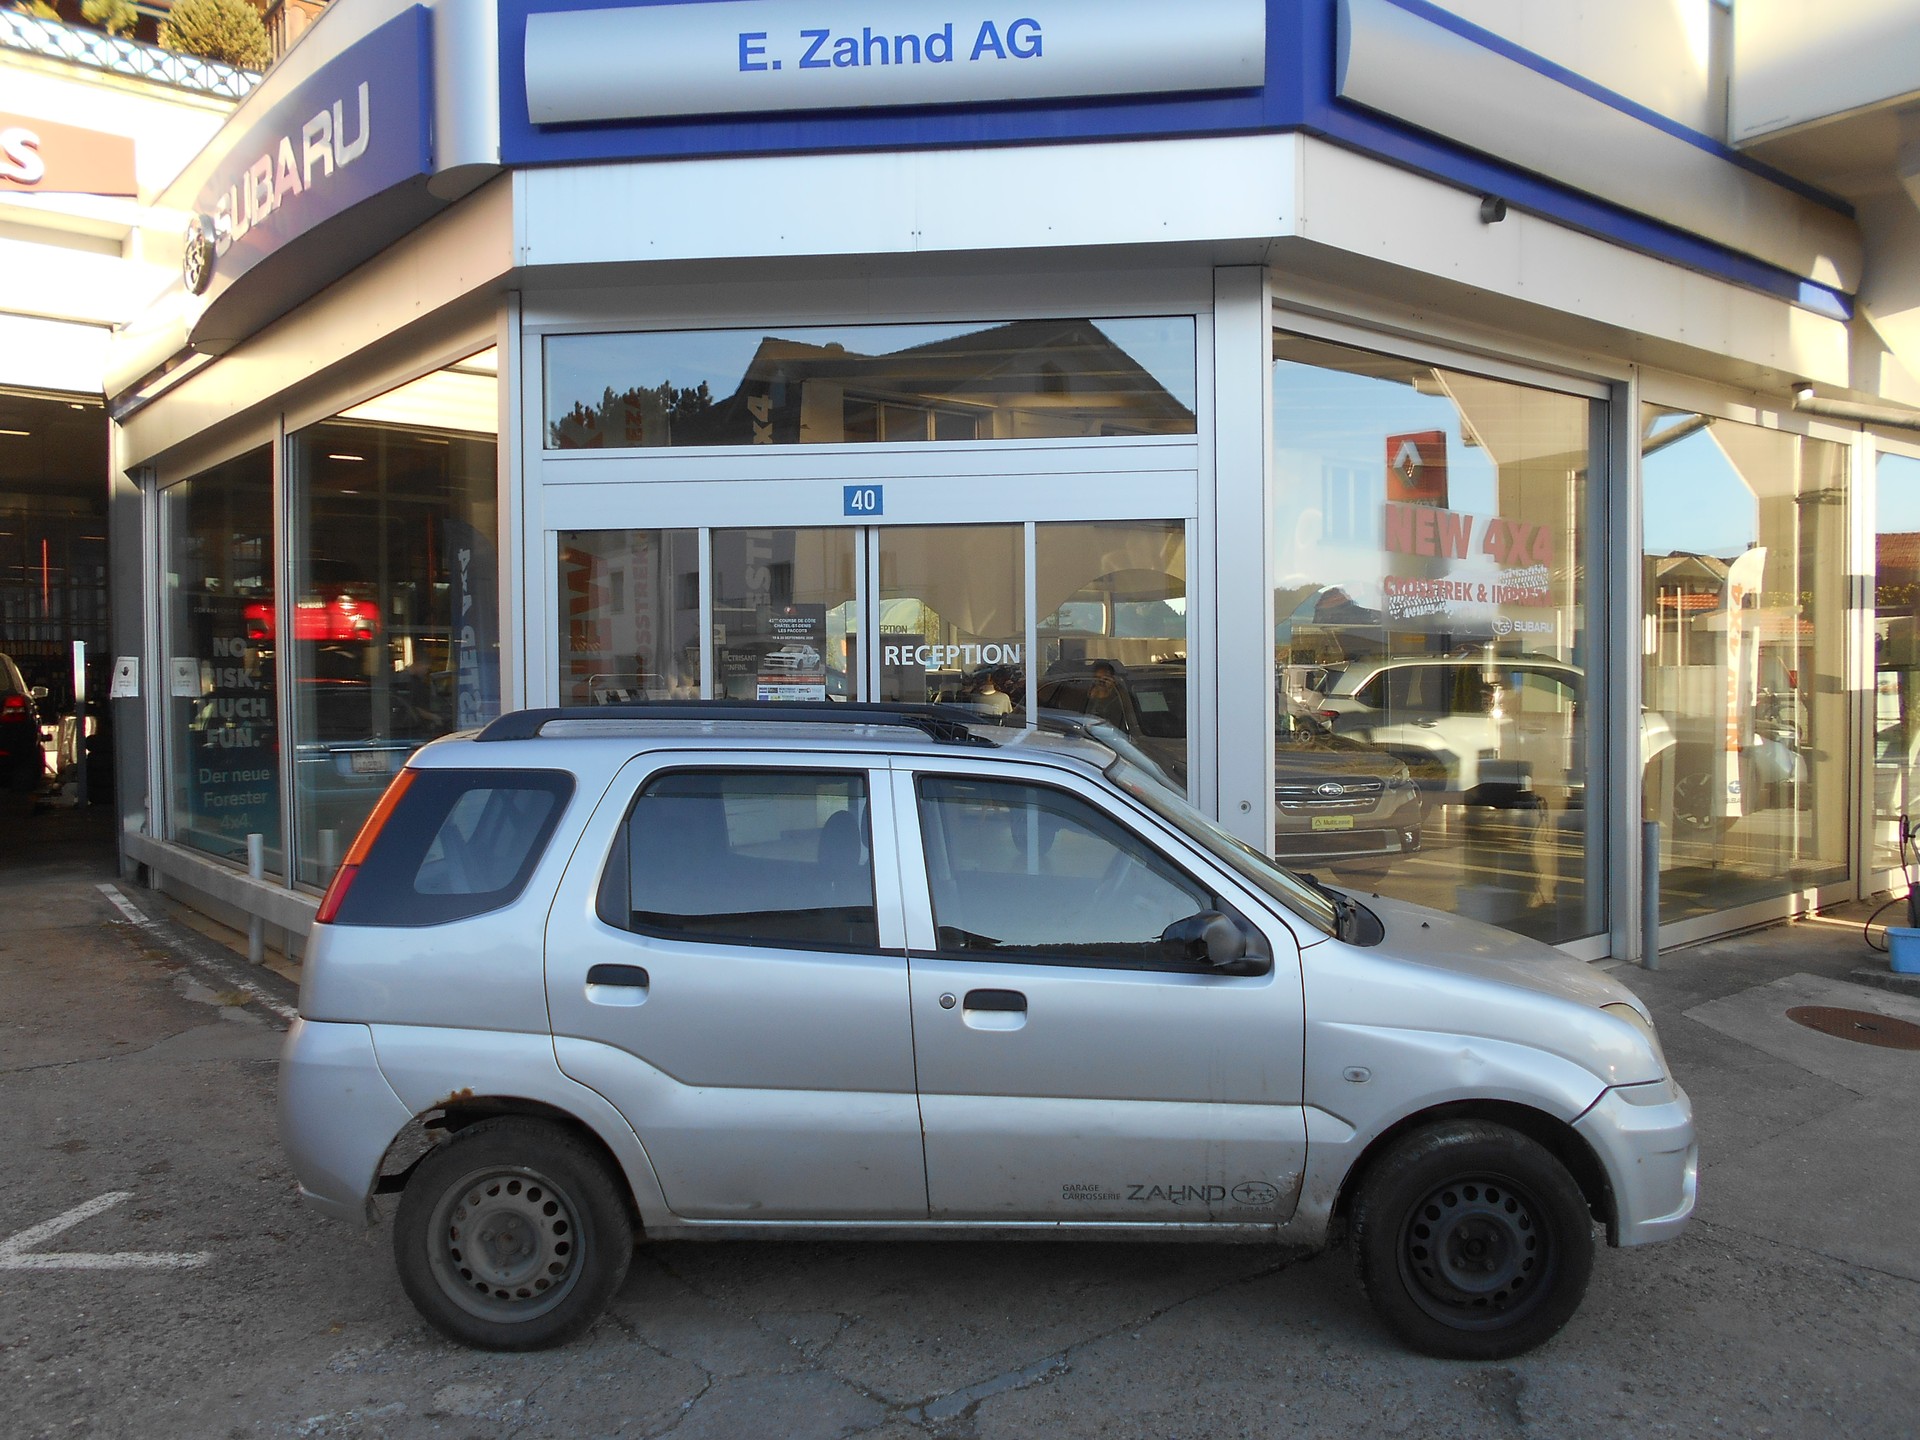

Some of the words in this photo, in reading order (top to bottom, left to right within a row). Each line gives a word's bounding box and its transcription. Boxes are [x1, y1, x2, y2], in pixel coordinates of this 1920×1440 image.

[738, 32, 782, 72] E.
[799, 24, 953, 70] Zahnd
[969, 17, 1043, 62] AG
[0, 127, 45, 185] S
[213, 81, 371, 258] SUBARU
[850, 489, 876, 511] 40
[1385, 503, 1473, 559] NEW
[1482, 518, 1554, 568] 4X4
[1383, 574, 1474, 602] CROSSTREK
[1476, 583, 1488, 604] &
[879, 624, 908, 634] EPTION
[1513, 623, 1554, 633] SUBARU
[213, 637, 247, 658] NO
[884, 643, 1021, 666] RECEPTION
[207, 727, 261, 749] FUN.
[199, 767, 227, 784] Der
[231, 768, 271, 783] neue
[203, 788, 269, 808] Forester
[1062, 1184, 1100, 1192] GARAGE
[1062, 1192, 1121, 1201] CARROSSERIE
[1126, 1184, 1227, 1202] ZAHND
